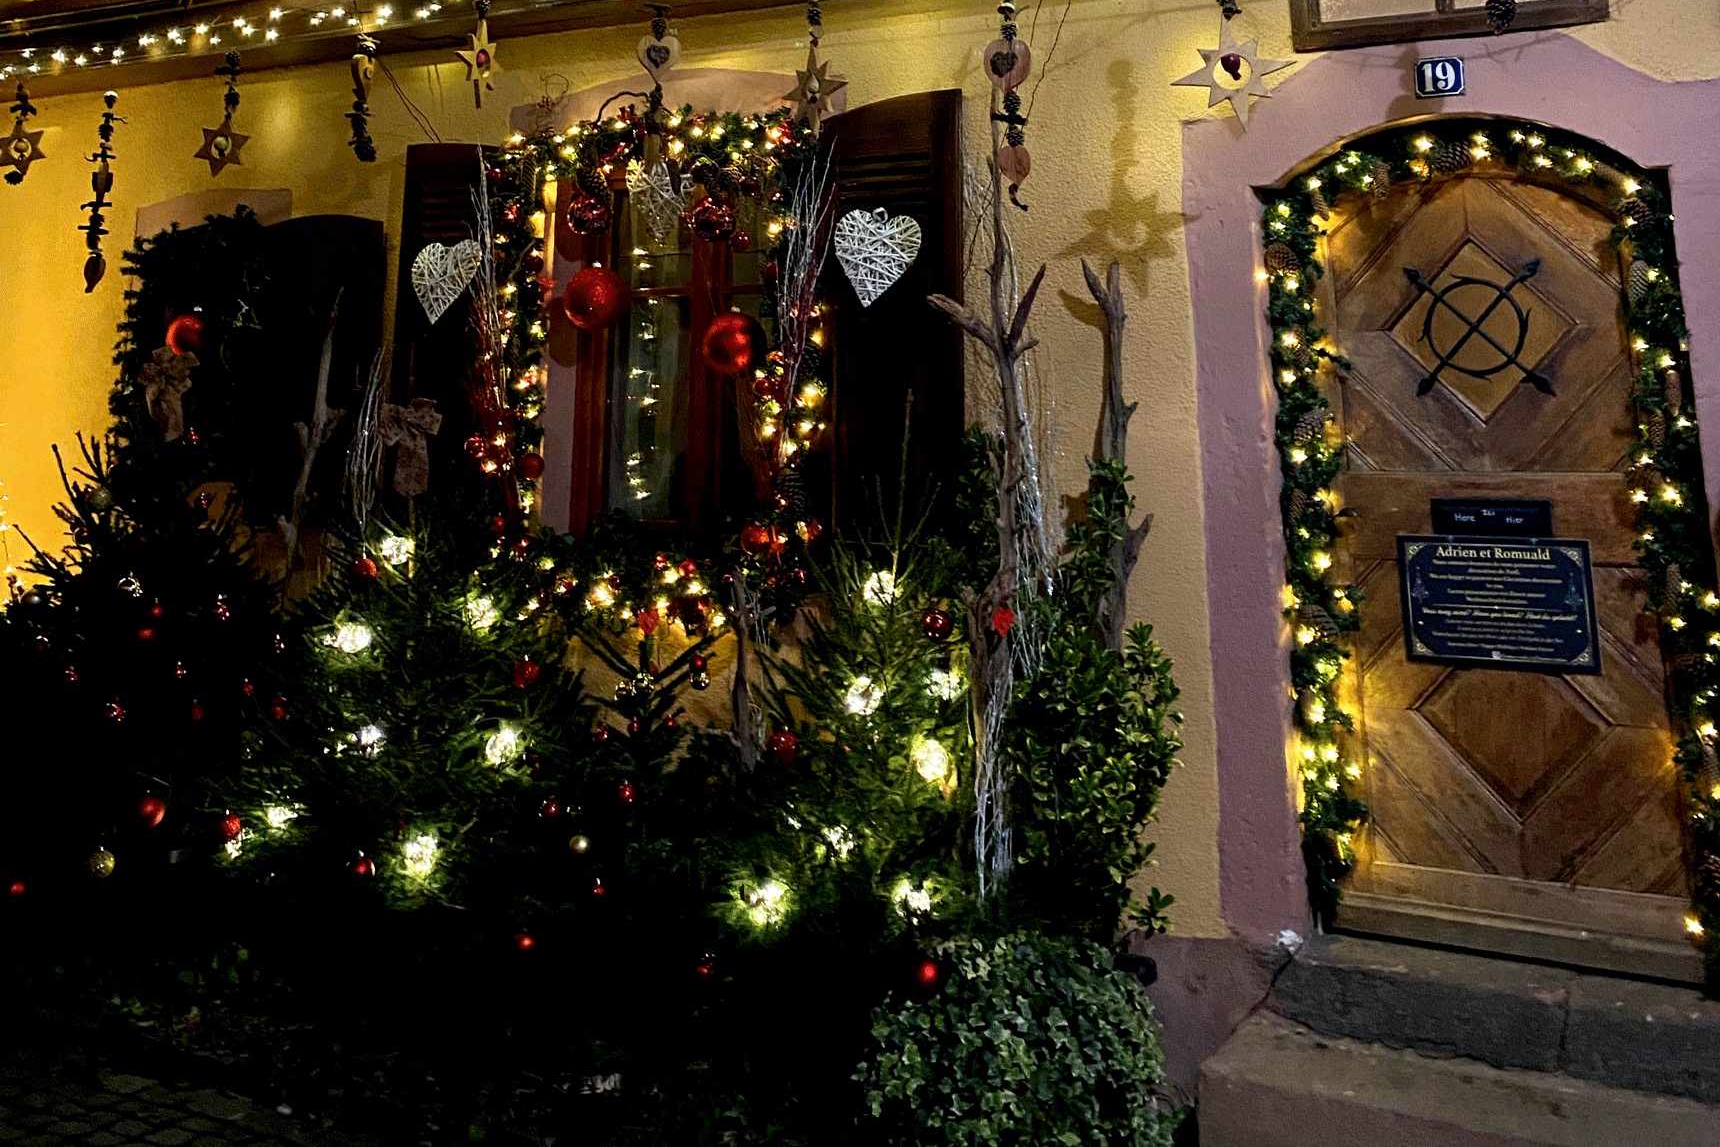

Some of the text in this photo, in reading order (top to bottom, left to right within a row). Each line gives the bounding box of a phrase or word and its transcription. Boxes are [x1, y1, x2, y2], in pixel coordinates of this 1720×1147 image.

[1421, 61, 1456, 92] 19
[1454, 513, 1476, 522] Here
[1505, 516, 1524, 524] Hier
[1436, 545, 1550, 560] Adrien et Romuald
